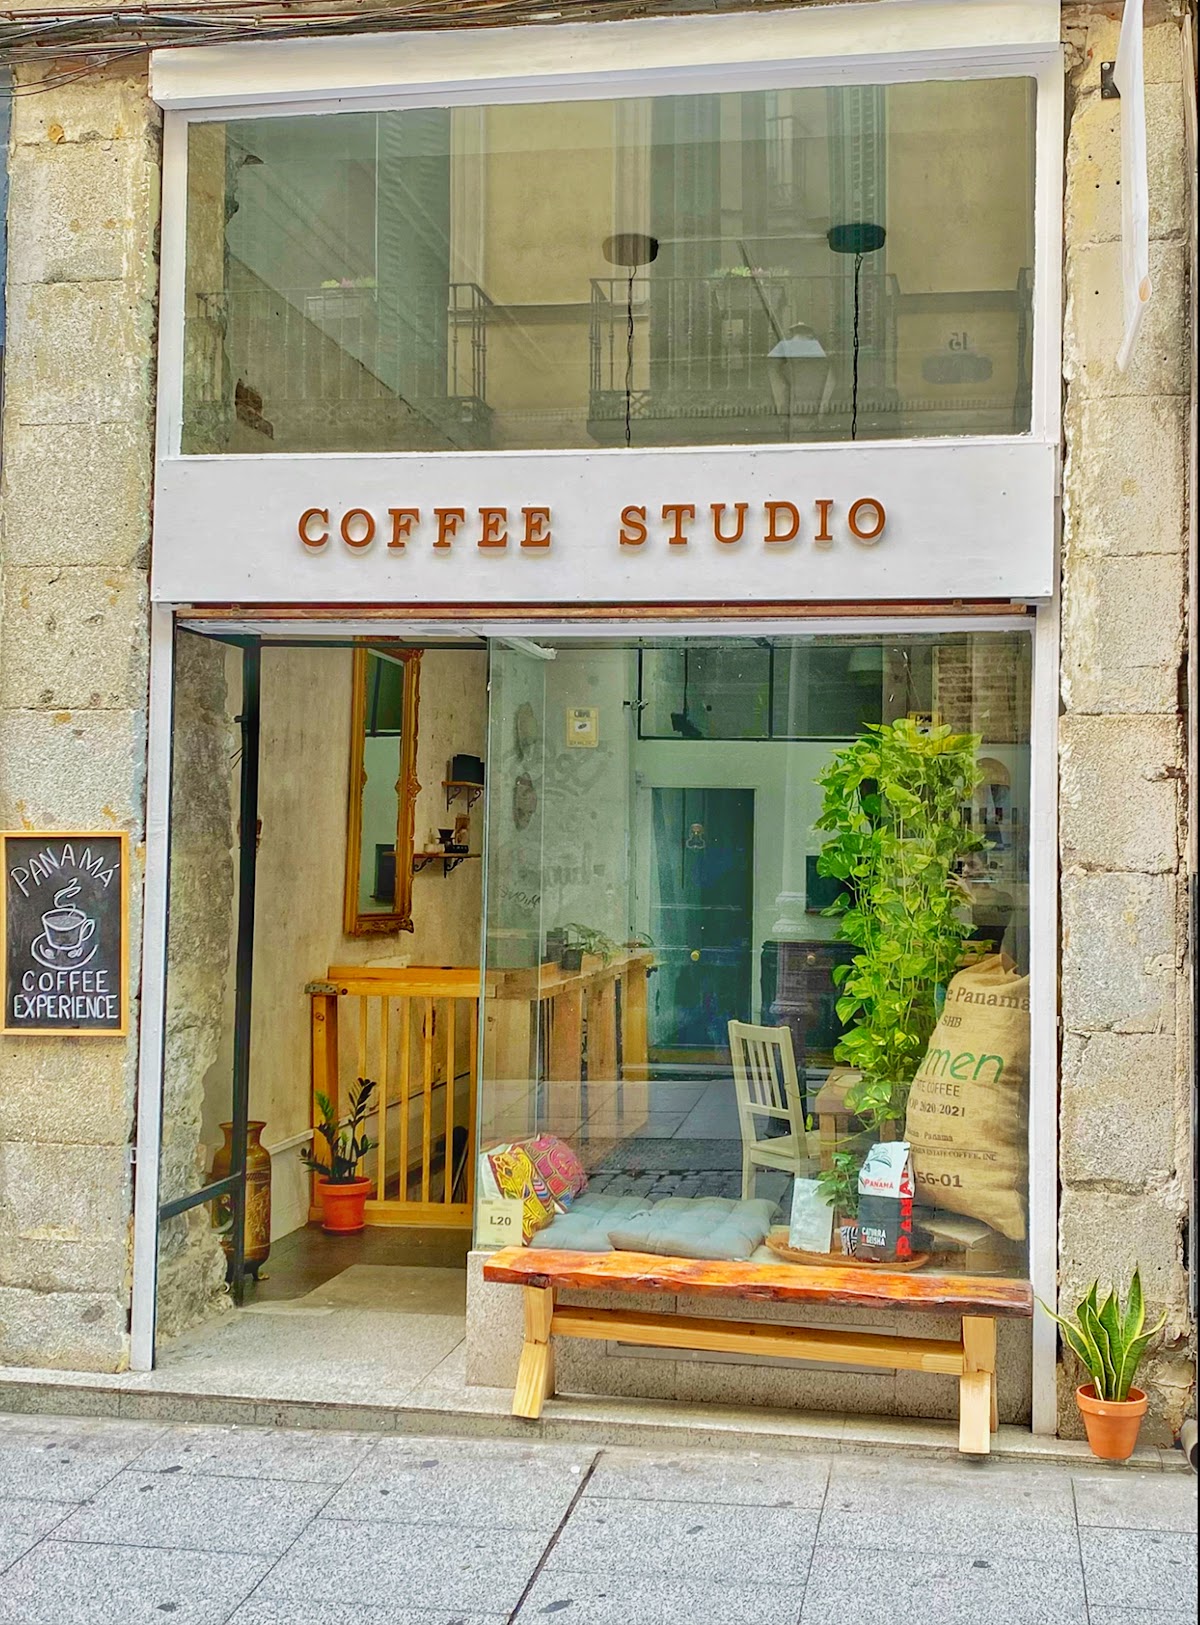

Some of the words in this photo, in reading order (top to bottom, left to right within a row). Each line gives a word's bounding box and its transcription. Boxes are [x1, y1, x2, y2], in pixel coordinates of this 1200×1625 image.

[298, 507, 551, 548] COFFEE
[619, 498, 886, 546] STUDIO
[22, 970, 110, 993] COFFEE
[14, 994, 119, 1019] EXPERIENCE
[955, 987, 1030, 1011] Panama
[941, 1015, 962, 1028] SHB
[926, 1082, 960, 1098] COFFEE
[490, 1216, 512, 1226] L20
